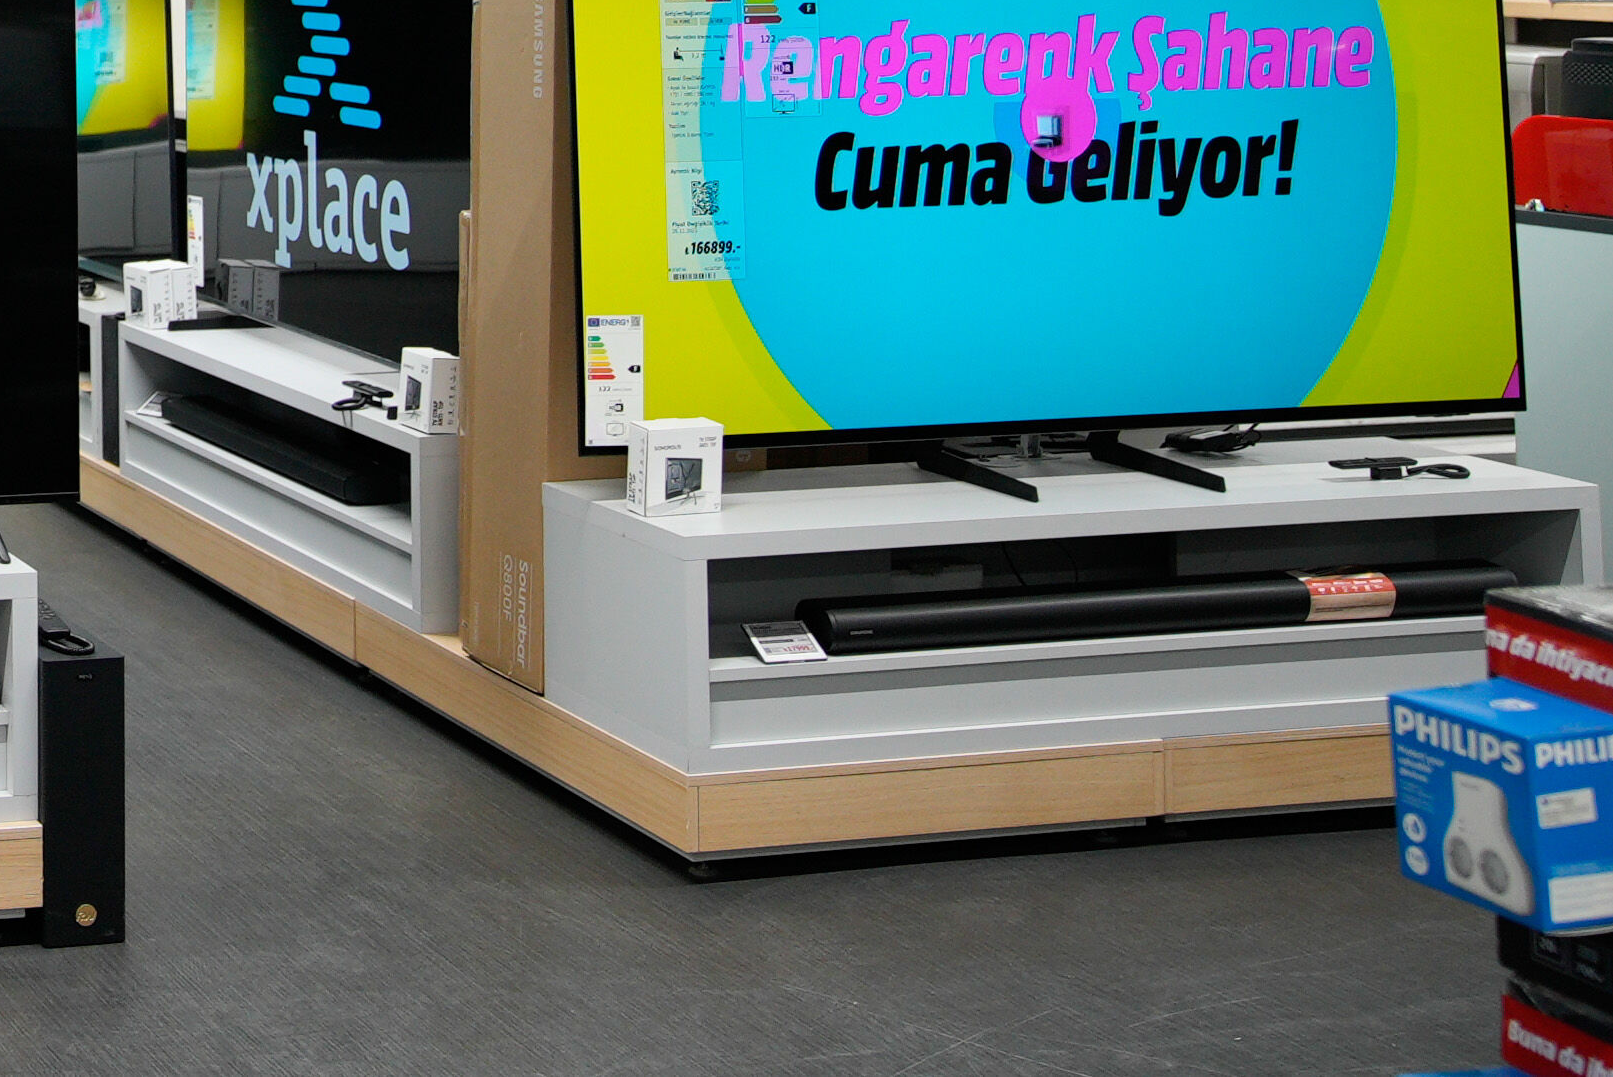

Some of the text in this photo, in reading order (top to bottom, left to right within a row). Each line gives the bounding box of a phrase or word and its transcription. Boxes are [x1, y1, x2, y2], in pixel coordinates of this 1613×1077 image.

[720, 11, 1375, 117] Rengarenk Şahane
[760, 34, 776, 44] 122
[246, 130, 411, 271] xplace
[815, 119, 1300, 217] Cuma Geliyor!
[502, 554, 514, 623] Q800F
[517, 559, 530, 670] Soundbar
[1393, 704, 1525, 776] PHILIPS
